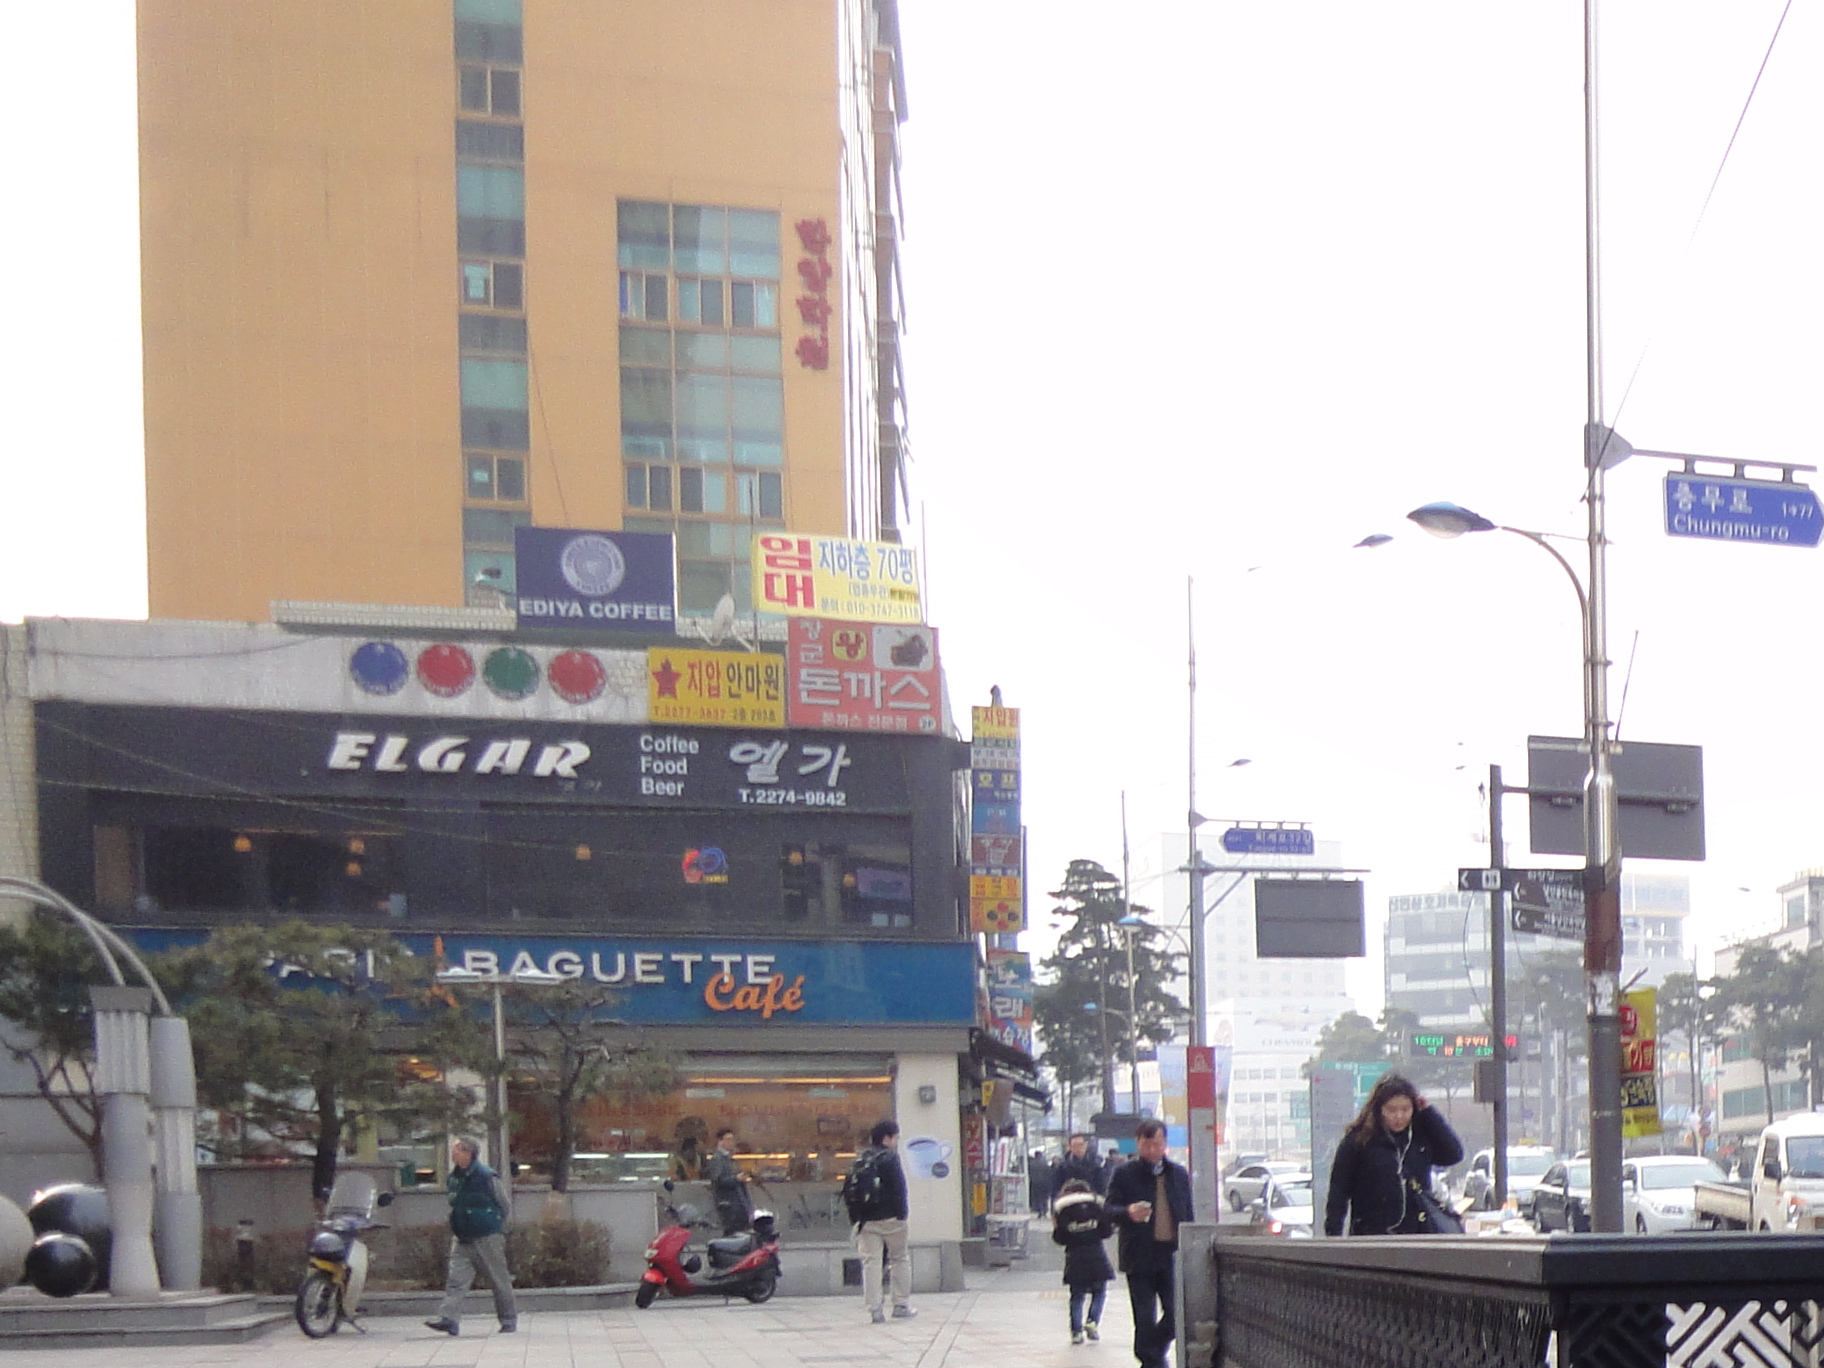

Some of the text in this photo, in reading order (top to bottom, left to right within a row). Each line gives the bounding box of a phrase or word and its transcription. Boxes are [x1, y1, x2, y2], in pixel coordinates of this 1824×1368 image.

[1673, 481, 1753, 515] 충무로
[1674, 513, 1790, 541] Chungmu-ro
[760, 537, 815, 609] 임대
[818, 541, 914, 585] 지하층 70평
[518, 599, 673, 621] EDIYA COFFEE
[687, 660, 779, 701] 지압 안마원
[799, 668, 932, 710] 돈까스
[328, 732, 591, 778] ELGAR
[640, 735, 699, 754] Coffee
[640, 756, 688, 775] Food
[640, 777, 685, 796] Beer
[463, 950, 775, 985] BAGUETTE
[704, 973, 805, 1018] Café
